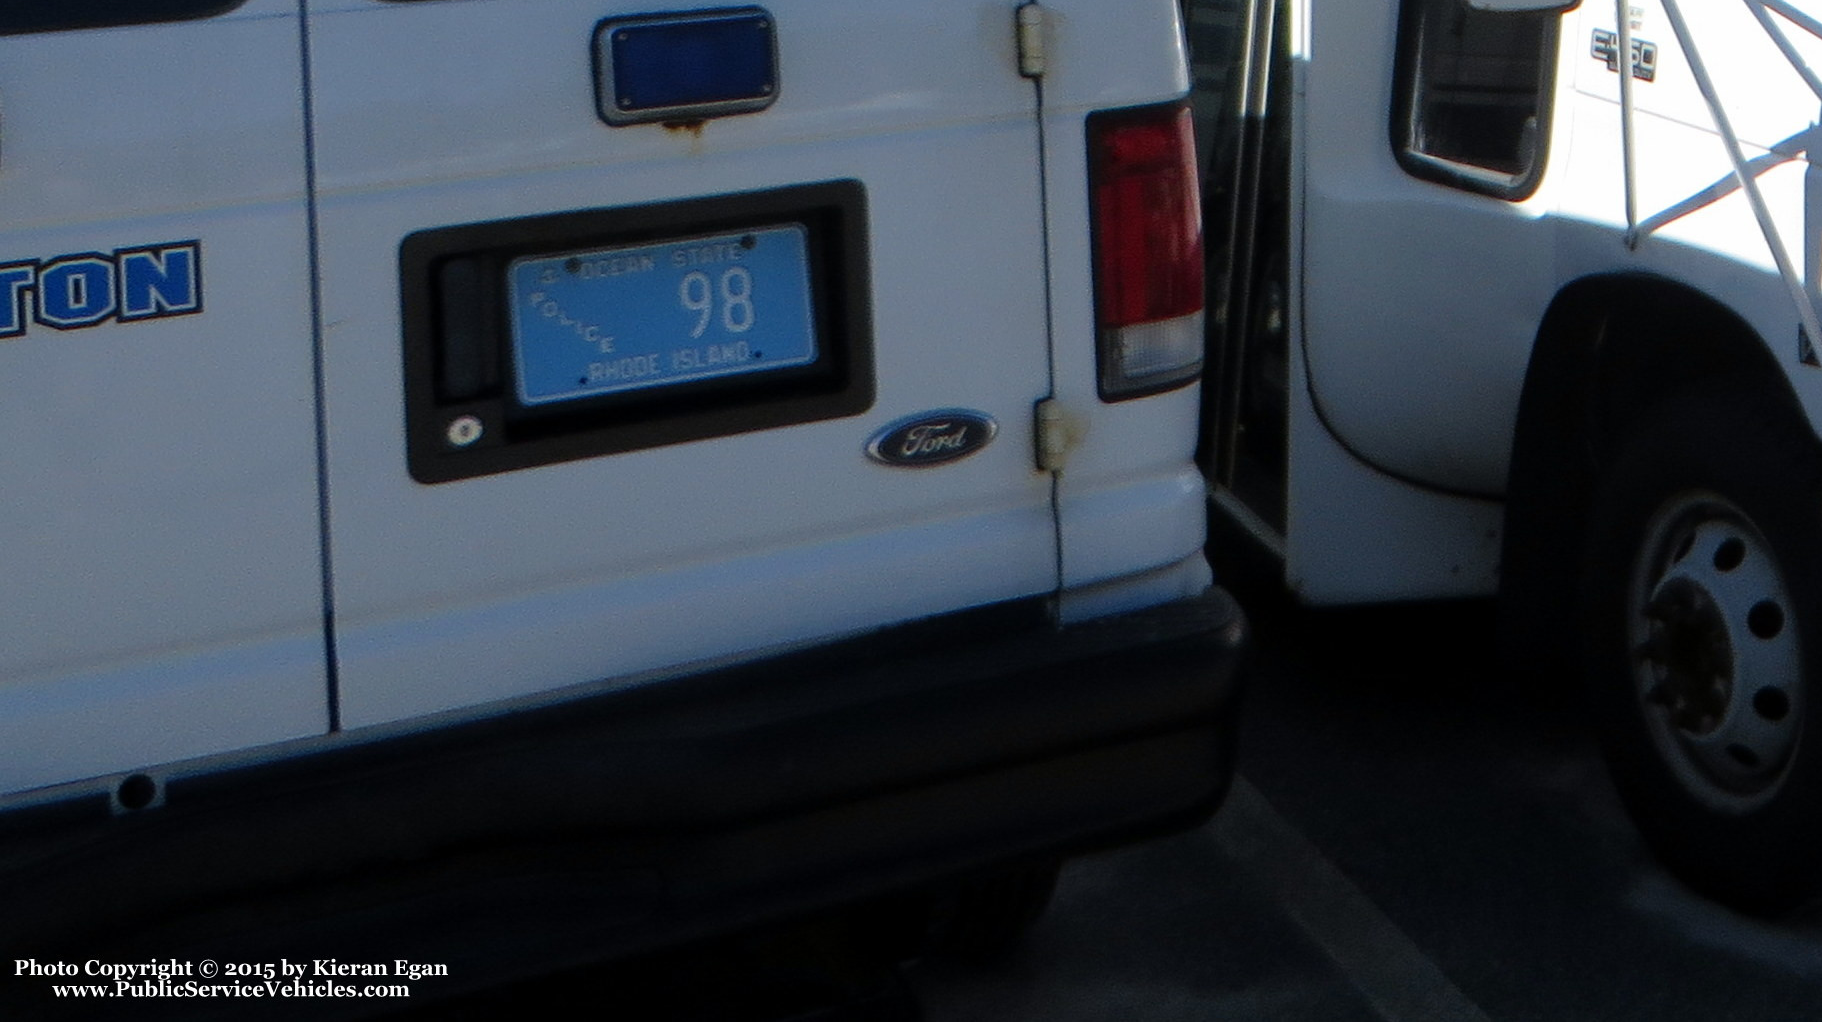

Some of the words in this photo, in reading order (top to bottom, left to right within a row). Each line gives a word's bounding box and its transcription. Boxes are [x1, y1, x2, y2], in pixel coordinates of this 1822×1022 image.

[578, 254, 655, 278] OCEAN
[671, 243, 744, 267] STATE
[679, 266, 755, 338] 98
[530, 292, 616, 353] POLICE
[588, 353, 660, 380] RHODE
[671, 341, 751, 371] ISLAND
[901, 422, 967, 456] Ford
